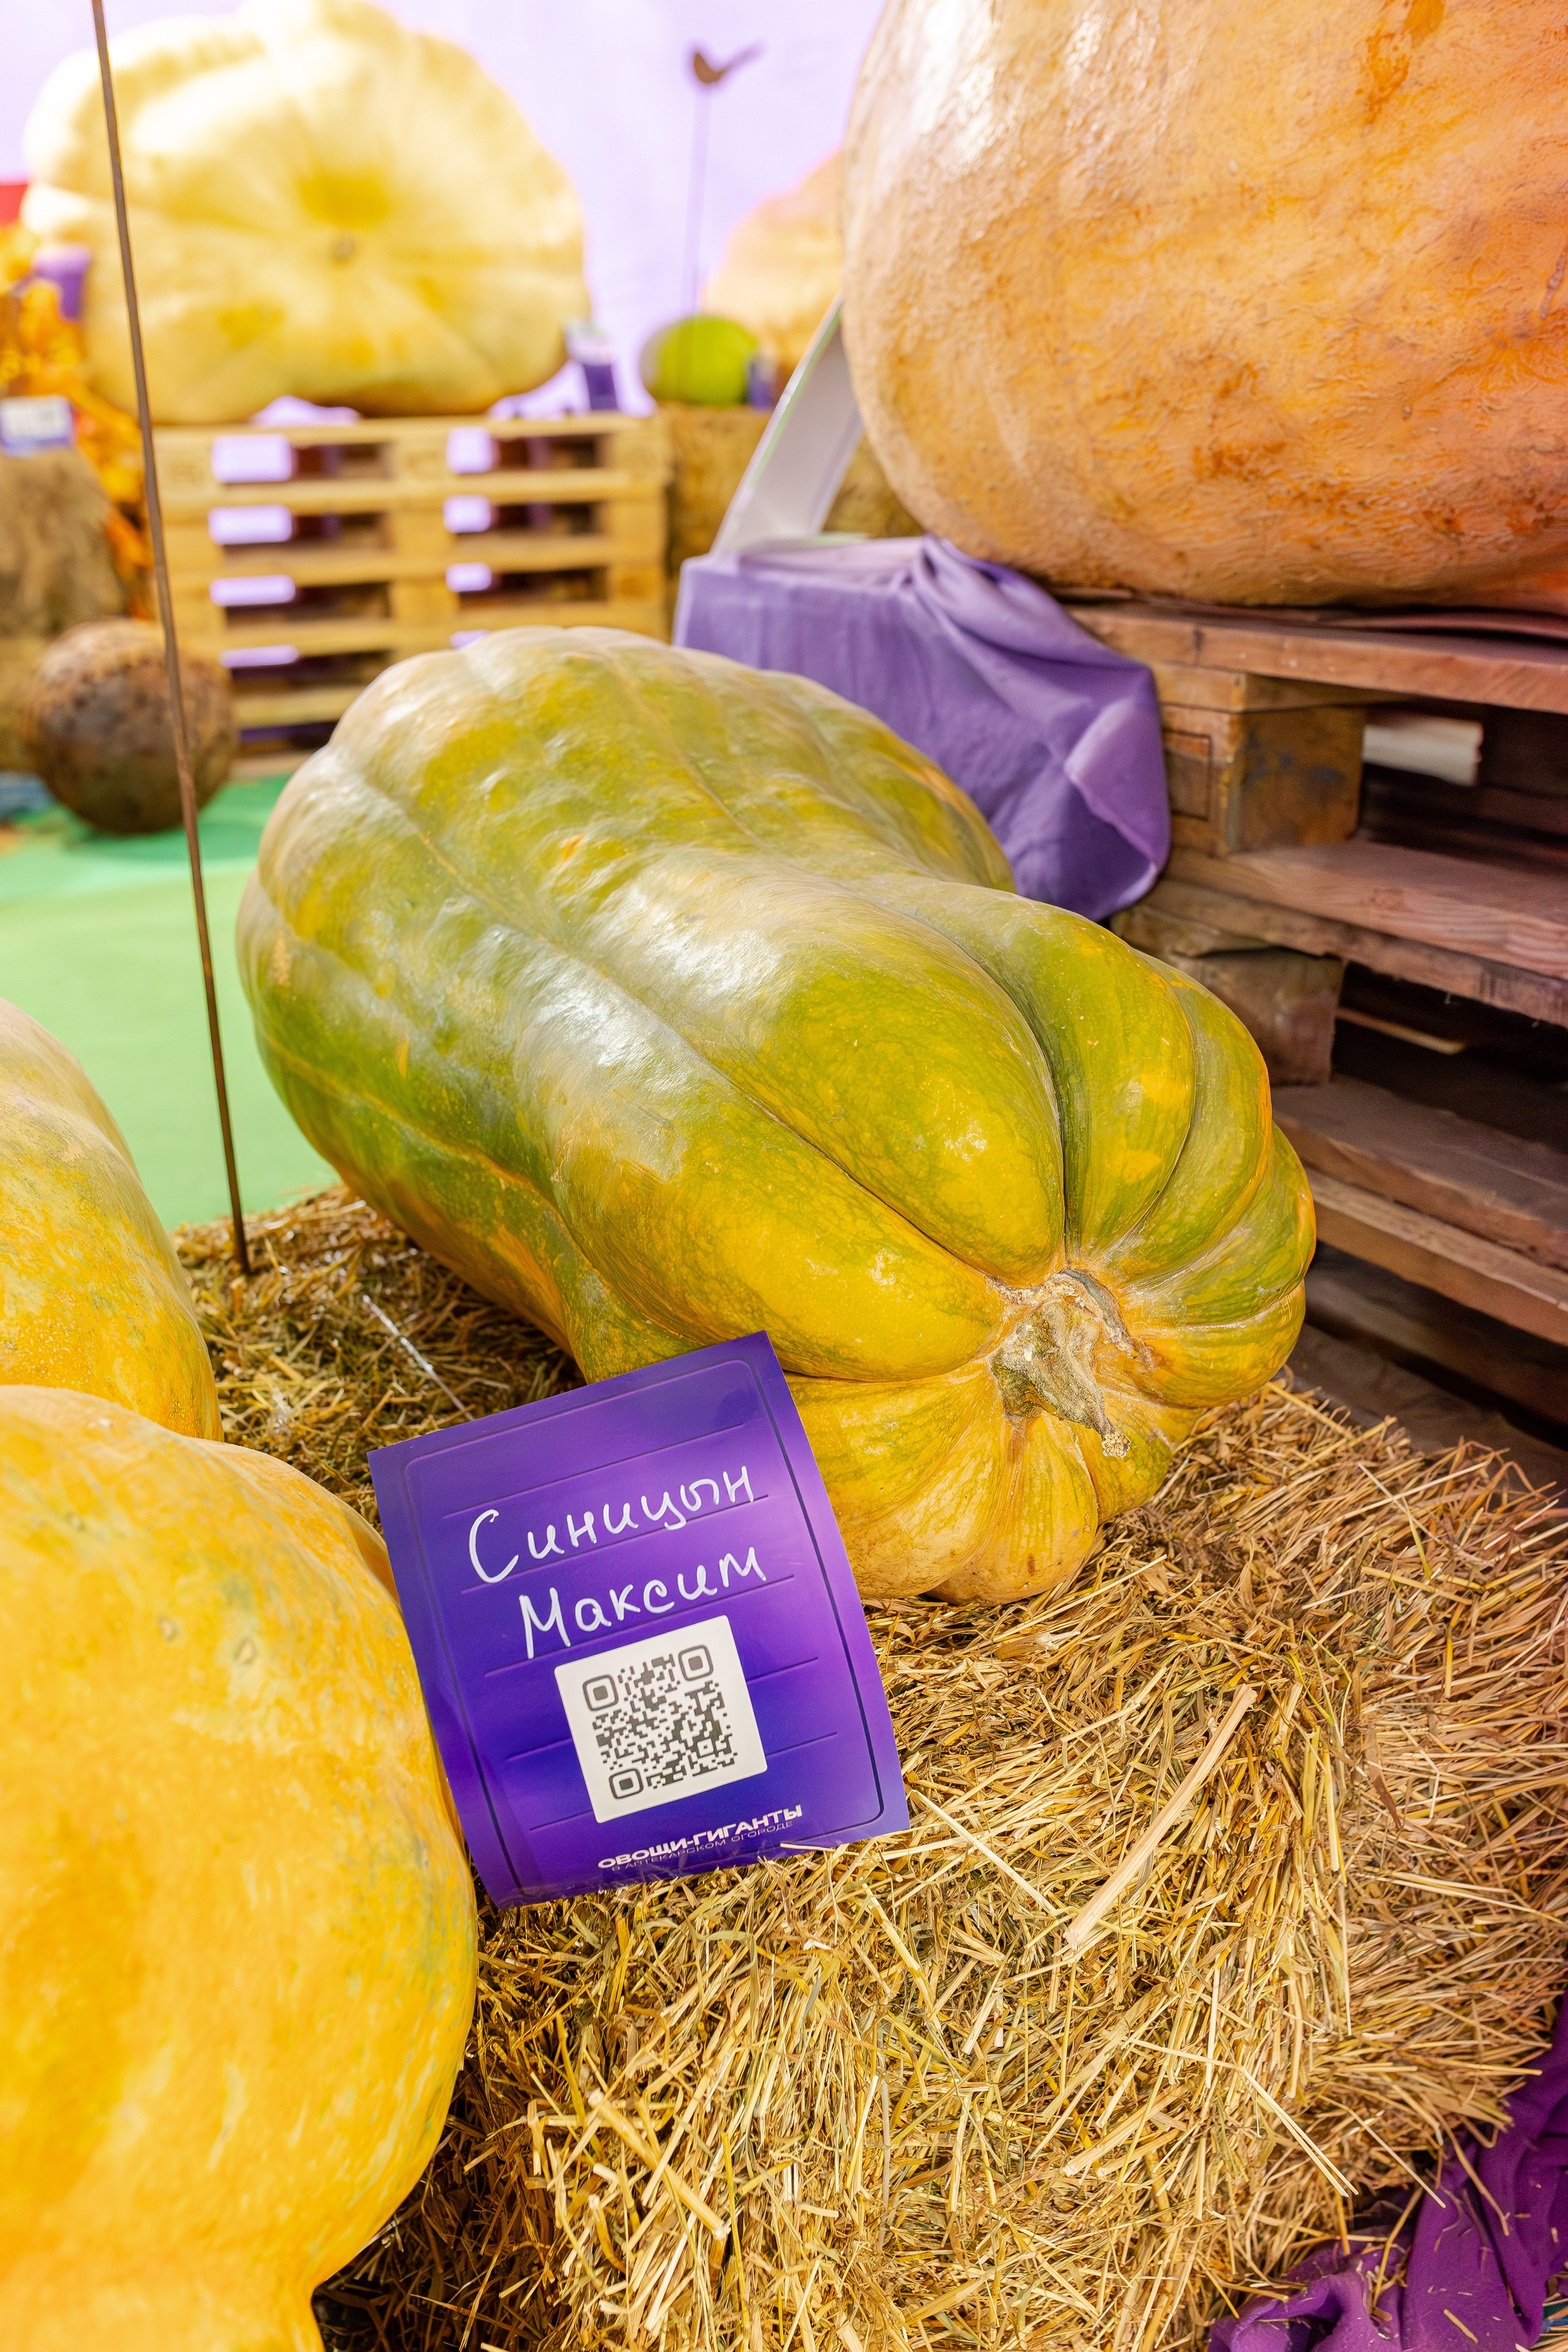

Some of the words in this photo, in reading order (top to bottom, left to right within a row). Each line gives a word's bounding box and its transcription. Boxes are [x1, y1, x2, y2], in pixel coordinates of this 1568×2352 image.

[469, 1466, 755, 1583] Синицын
[519, 1547, 767, 1659] Максим
[598, 1805, 802, 1869] ОВОЩИ-ГИГАНТЫ
